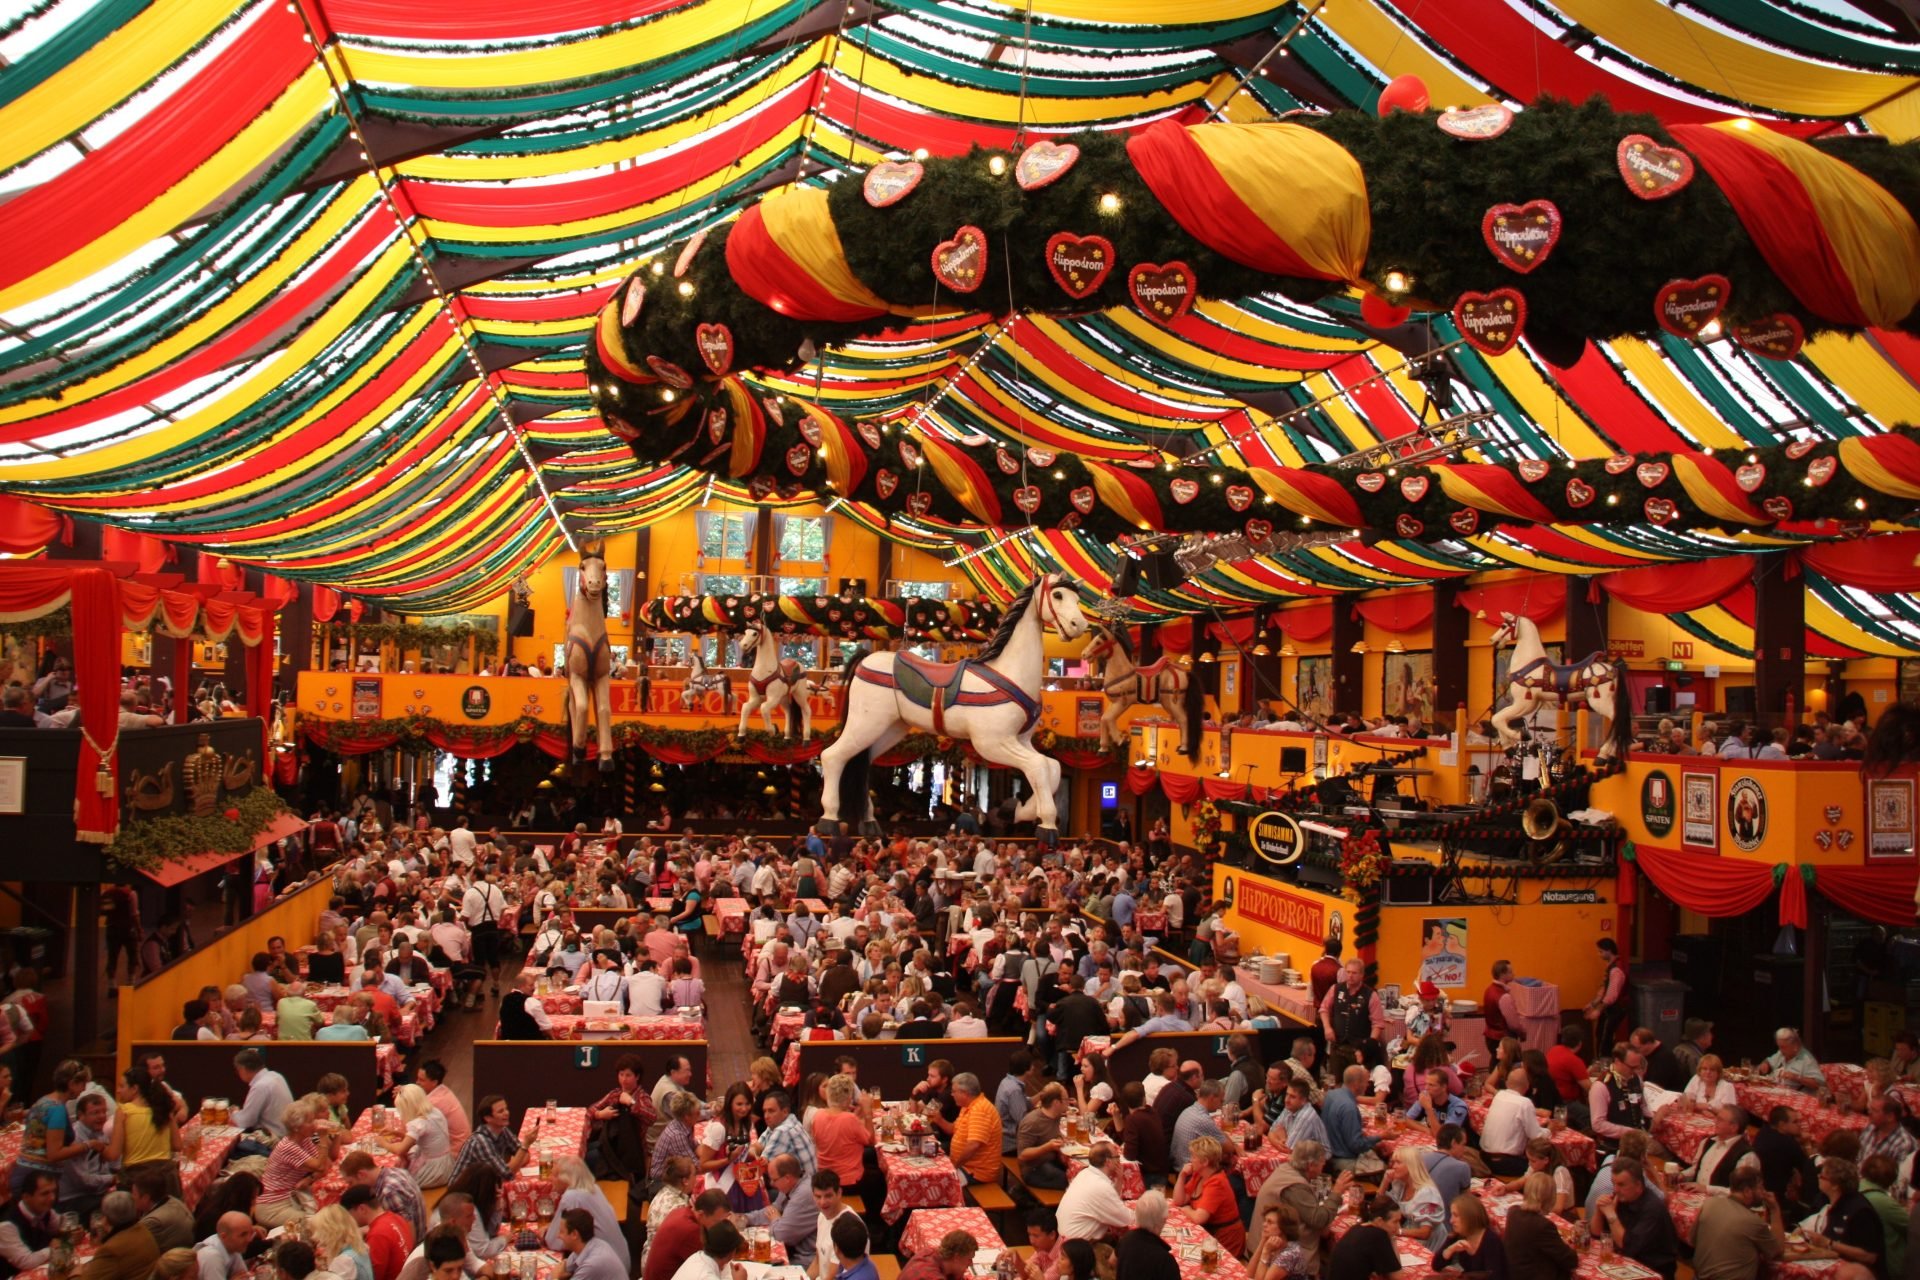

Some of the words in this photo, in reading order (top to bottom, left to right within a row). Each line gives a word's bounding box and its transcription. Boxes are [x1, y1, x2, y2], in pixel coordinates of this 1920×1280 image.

[940, 242, 980, 275] Hippodrom
[1053, 252, 1105, 273] Hippodrom
[1136, 283, 1188, 301] Hippodrom
[1664, 299, 1718, 317] Hippodrom
[1462, 312, 1514, 334] Hippodrom
[1645, 814, 1671, 825] SPATEN
[1543, 892, 1595, 903] Notausgang
[906, 1047, 921, 1063] K
